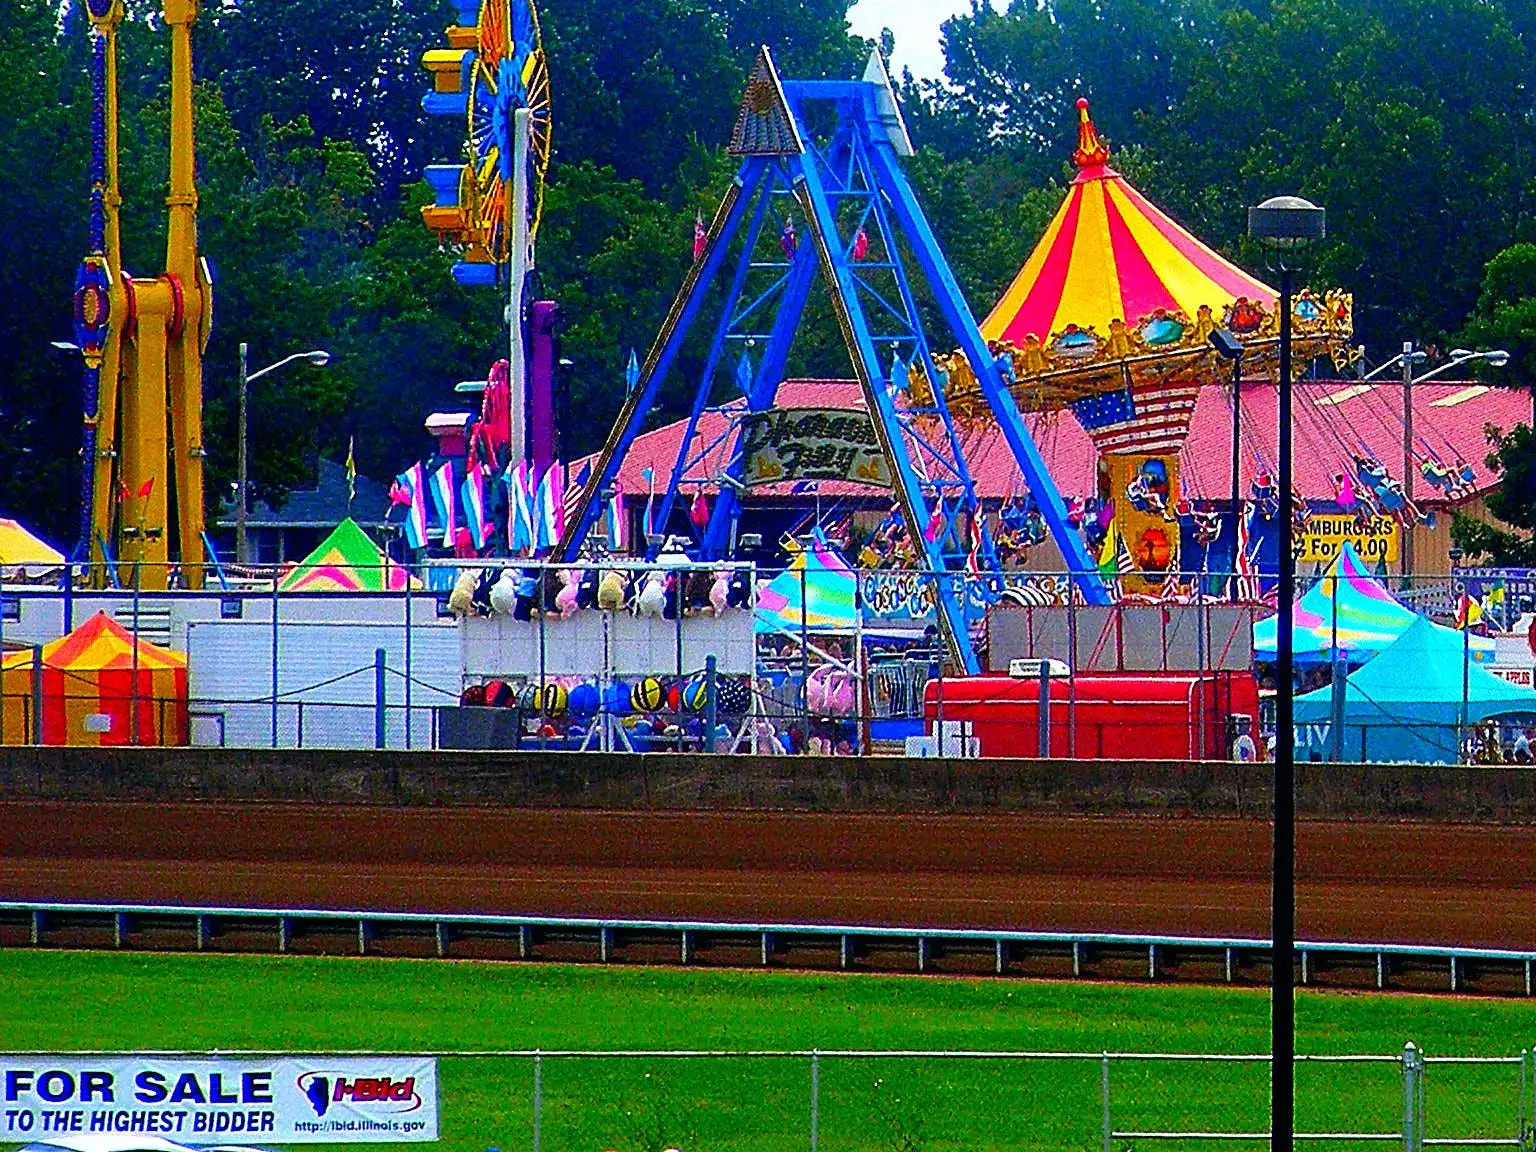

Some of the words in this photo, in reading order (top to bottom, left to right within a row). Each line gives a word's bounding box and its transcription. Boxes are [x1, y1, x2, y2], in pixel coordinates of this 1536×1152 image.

[1303, 520, 1393, 536] MBURGRS
[1312, 539, 1338, 555] For
[1352, 539, 1388, 556] 4.00
[6, 1070, 115, 1103] FOR
[134, 1071, 273, 1104] SALE
[6, 1110, 34, 1132] TO
[41, 1110, 84, 1132] THE
[90, 1110, 188, 1132] HIGHEST
[193, 1111, 275, 1133] BIDDER
